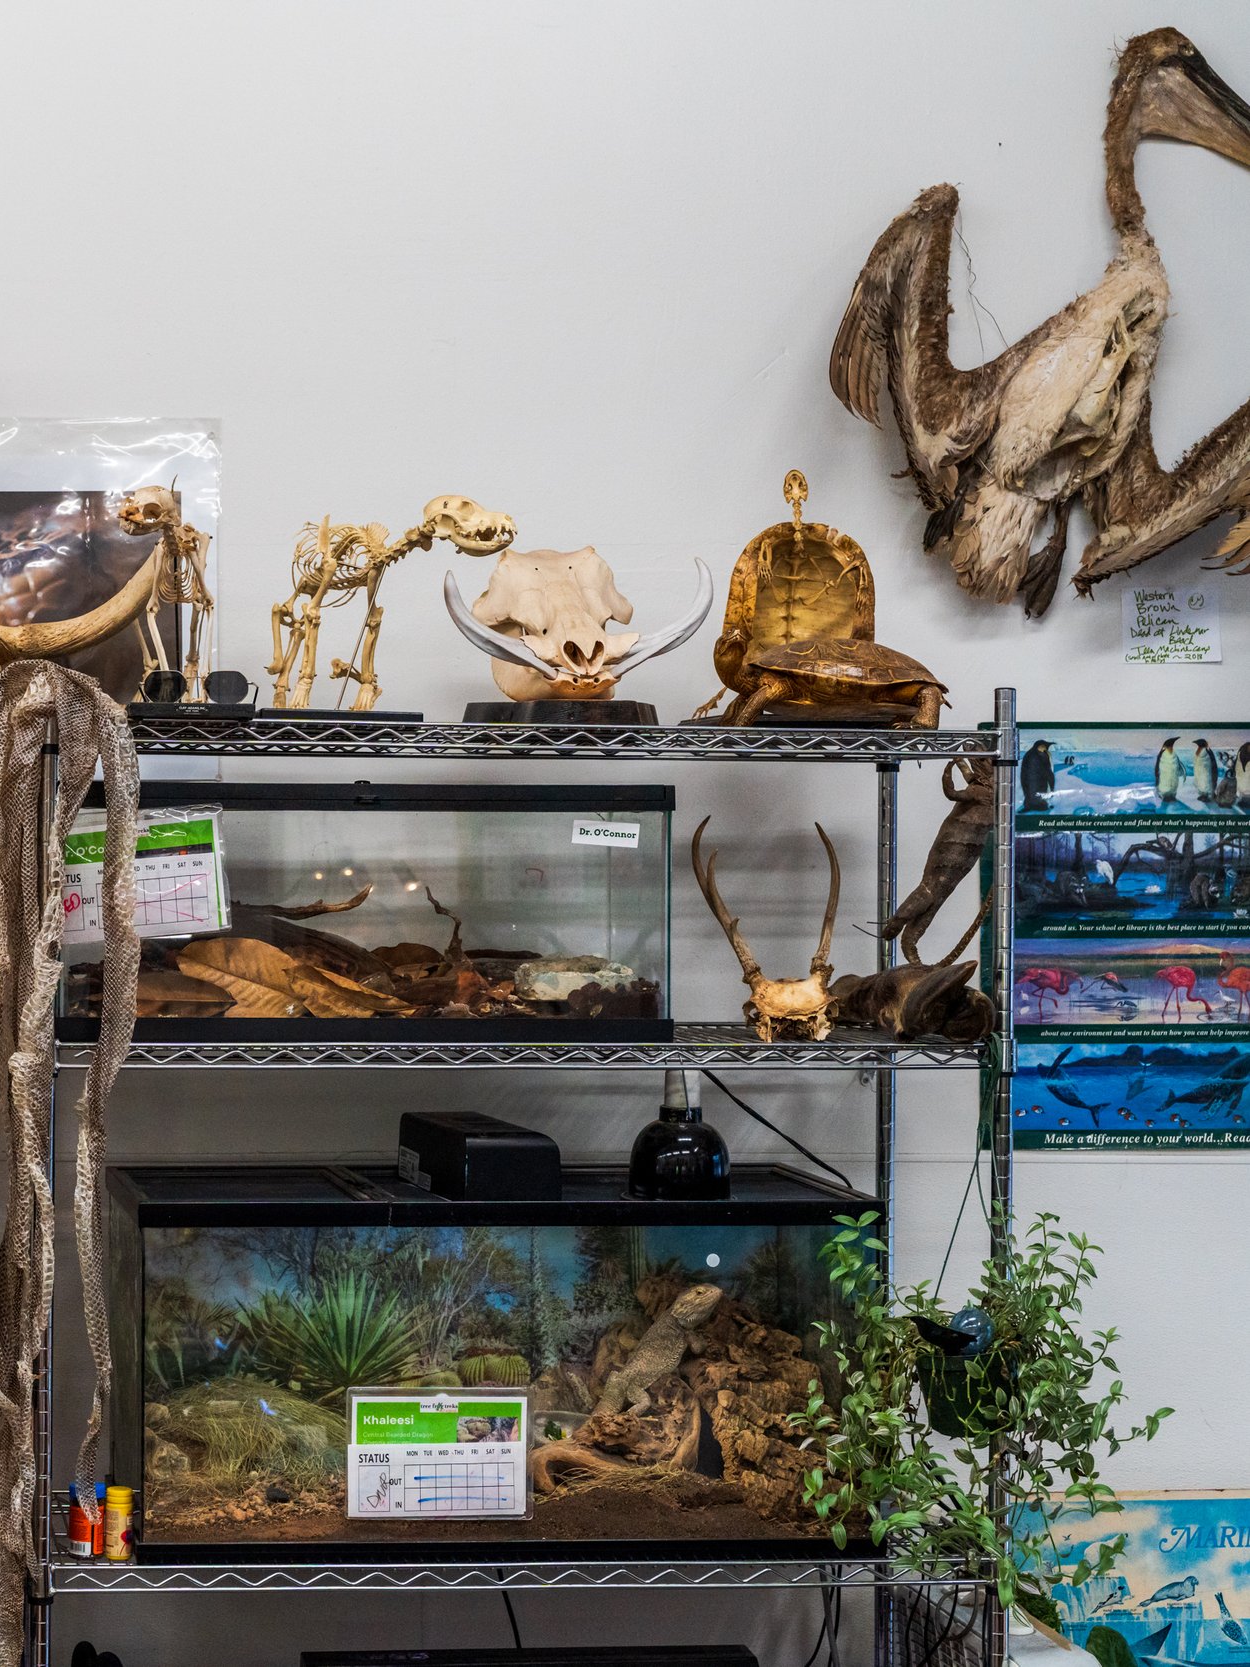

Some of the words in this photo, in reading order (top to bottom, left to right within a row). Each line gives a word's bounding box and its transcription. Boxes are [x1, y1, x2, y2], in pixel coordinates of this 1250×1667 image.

[1134, 589, 1174, 602] Western
[1136, 602, 1181, 614] Brown
[1136, 614, 1179, 628] Pelican
[1137, 819, 1150, 827] find
[1185, 819, 1218, 827] happening
[579, 828, 592, 836] Dr.
[594, 829, 637, 839] O'Connor
[89, 919, 97, 927] IN
[1126, 924, 1147, 932] library
[1180, 924, 1196, 932] place
[1210, 1029, 1223, 1037] help
[1225, 1029, 1249, 1037] improve
[1044, 1133, 1074, 1144] Make
[1077, 1136, 1084, 1144] a
[1086, 1133, 1140, 1145] difference
[1143, 1134, 1153, 1143] to
[1156, 1135, 1182, 1145] your
[363, 1415, 414, 1425] Khaleesi
[358, 1453, 390, 1463] STATUS
